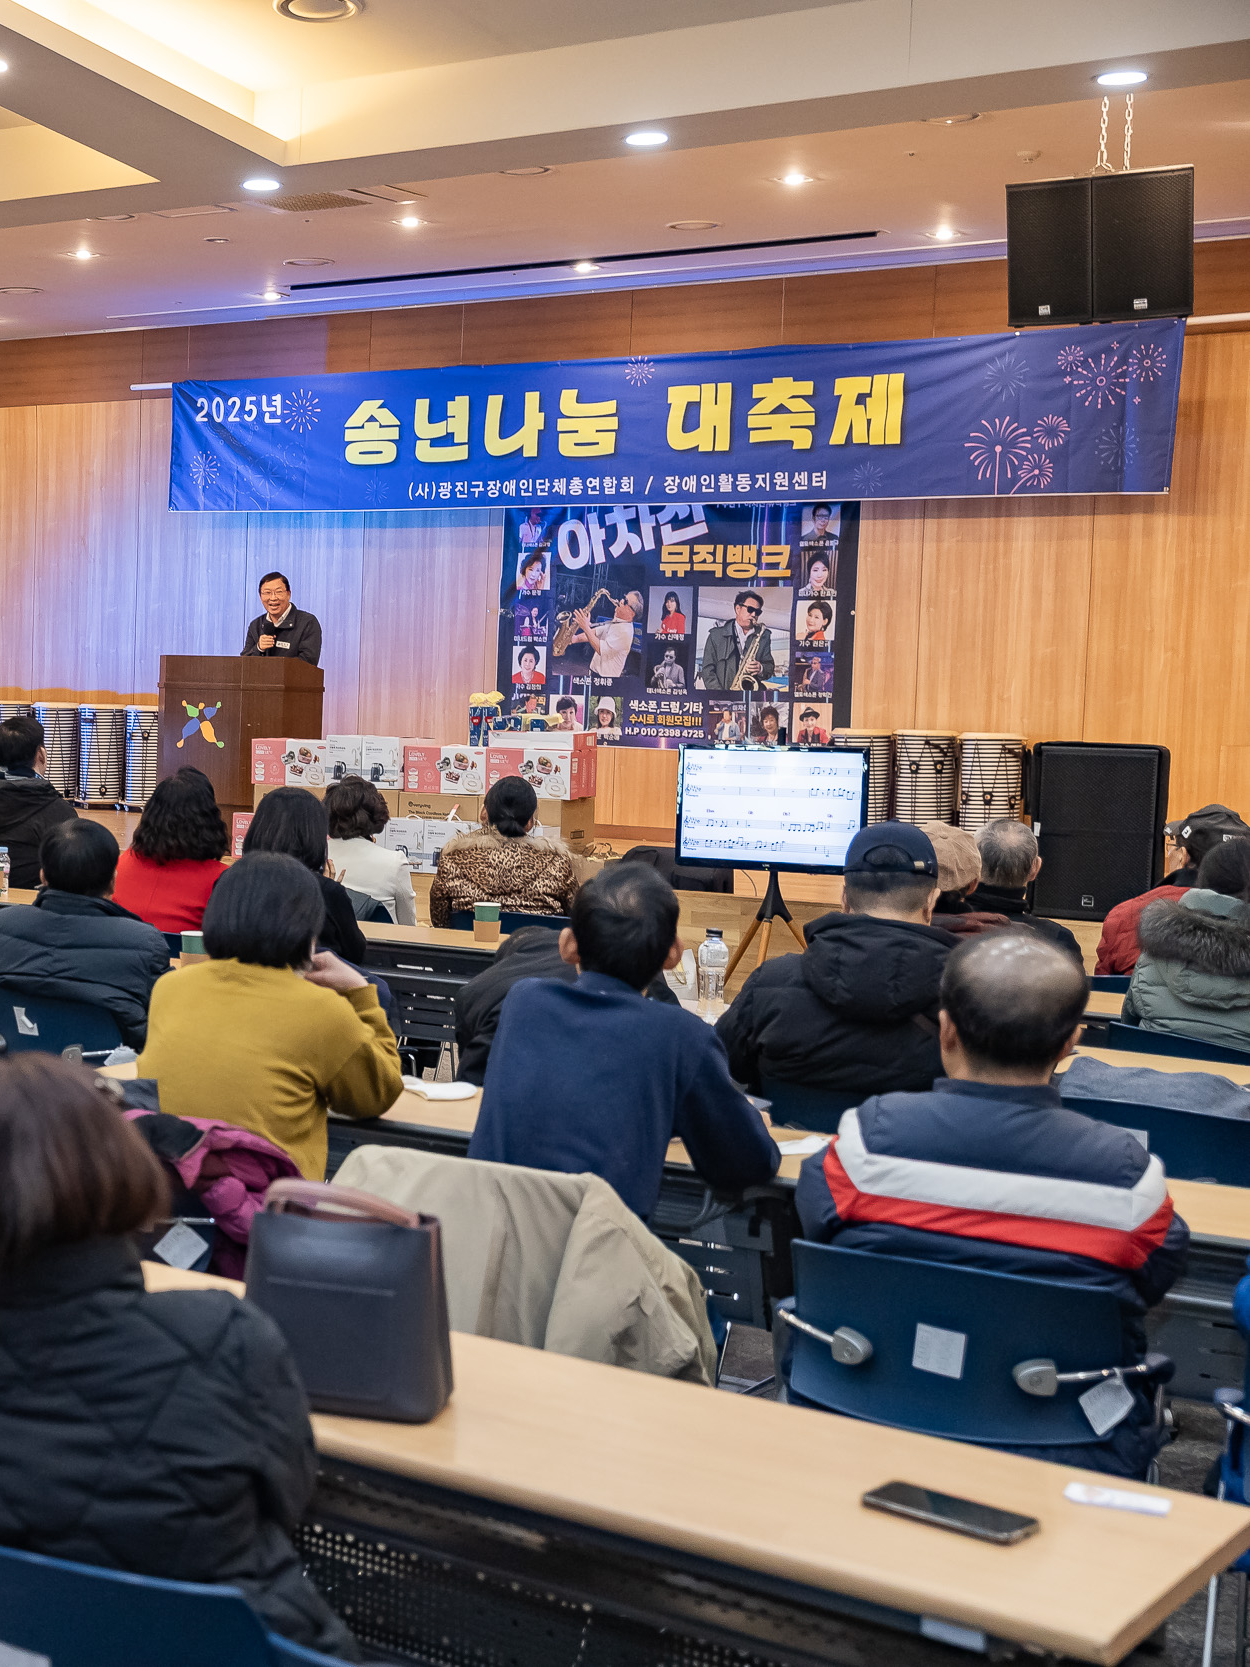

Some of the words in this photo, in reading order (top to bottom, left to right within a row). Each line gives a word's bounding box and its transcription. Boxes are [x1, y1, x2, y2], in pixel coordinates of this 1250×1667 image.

[196, 393, 283, 424] 2025년
[343, 388, 619, 466] 송년나눔
[666, 373, 905, 452] 대축제
[408, 475, 635, 500] (사)광진구장애인단체총연합회
[663, 470, 828, 493] 장애인활동지원센터
[659, 544, 791, 579] 뮤직뱅크
[655, 633, 666, 641] 가수
[573, 677, 592, 686] 색소폰
[629, 700, 704, 715] 색소폰,드럼,기타
[629, 714, 656, 725] 수시로
[657, 715, 702, 727] 회원모집!!!
[625, 727, 640, 735] H.P
[640, 727, 657, 736] 010
[658, 728, 681, 738] 2398
[682, 729, 705, 739] 4725
